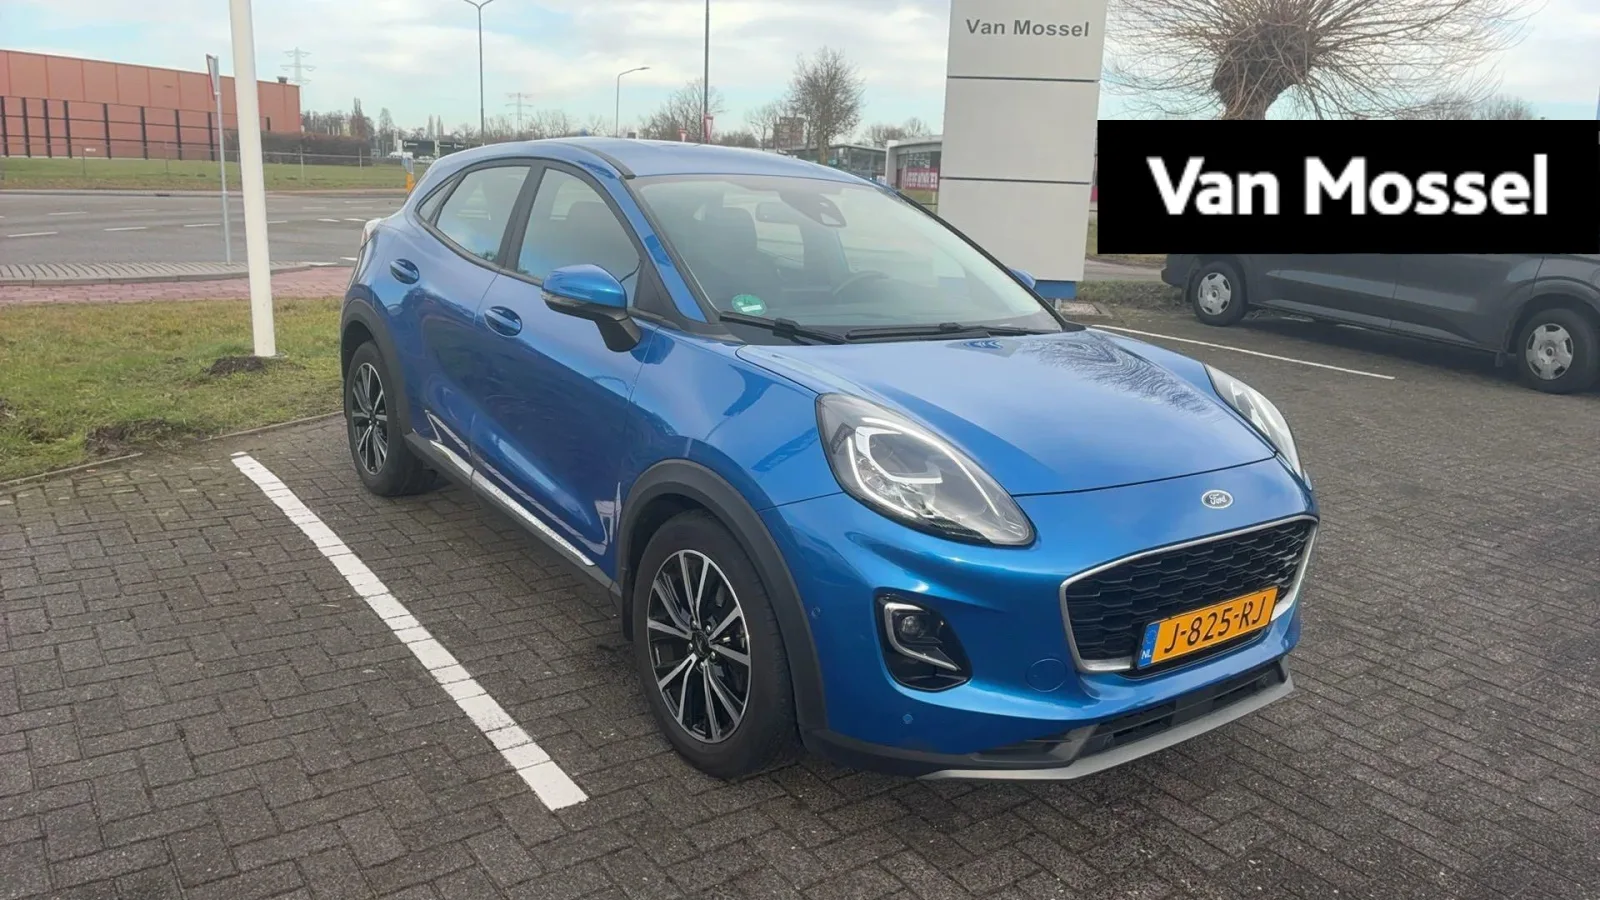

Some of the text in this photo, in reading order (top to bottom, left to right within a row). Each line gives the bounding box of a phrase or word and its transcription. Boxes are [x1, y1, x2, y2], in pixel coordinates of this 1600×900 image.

[966, 19, 1089, 37] Van Mossel
[1208, 493, 1228, 505] Ford
[1163, 596, 1267, 654] J-825-RJ
[1141, 649, 1152, 660] NL
